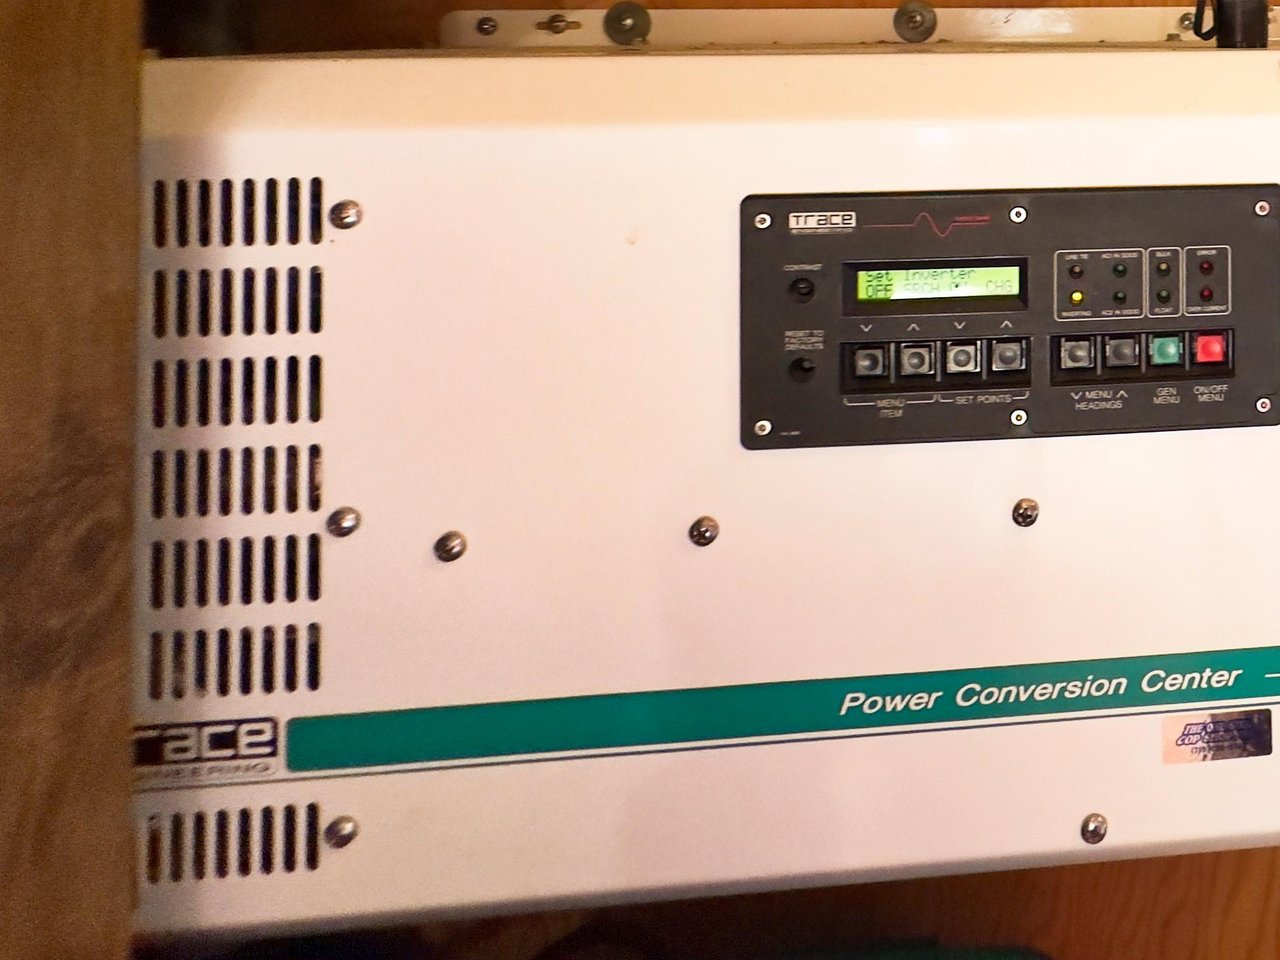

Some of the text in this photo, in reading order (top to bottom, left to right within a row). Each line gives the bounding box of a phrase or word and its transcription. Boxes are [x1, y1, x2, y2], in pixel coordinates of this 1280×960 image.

[866, 269, 977, 283] Set Inverter
[866, 284, 893, 298] OFF
[985, 280, 1013, 293] CHG
[1157, 387, 1177, 395] GEN
[1193, 385, 1228, 394] ON/OFF
[955, 394, 1012, 404] SET POINTS
[1085, 391, 1113, 399] MENU
[1198, 394, 1224, 402] MENU
[877, 399, 905, 407] MENU
[1153, 396, 1180, 404] MENU
[1075, 400, 1123, 410] HEADINGS
[879, 409, 903, 418] ITEM
[840, 667, 1243, 715] Power Conversion Center
